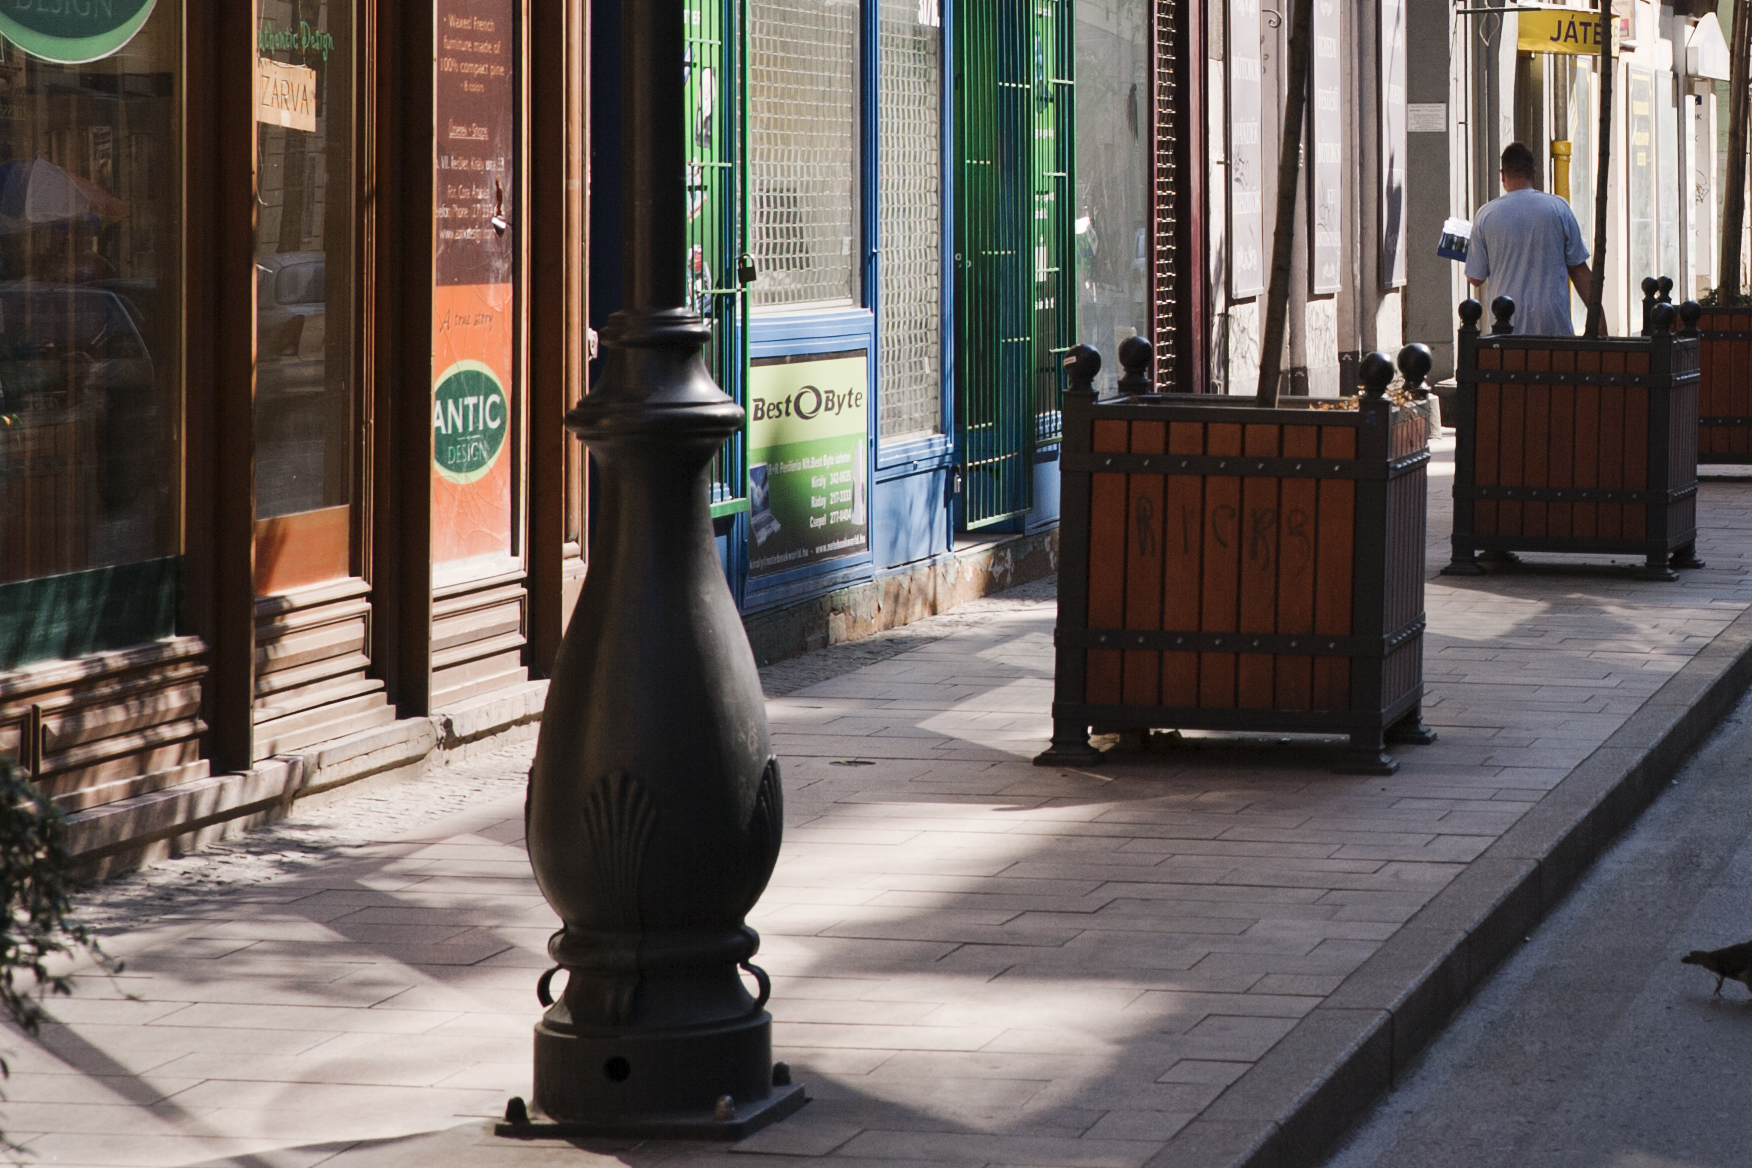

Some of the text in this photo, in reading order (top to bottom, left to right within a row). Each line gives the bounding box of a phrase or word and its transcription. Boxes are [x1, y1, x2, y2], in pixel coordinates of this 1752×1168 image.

[261, 71, 310, 115] ZÁRVA
[434, 393, 501, 435] ANTIC
[448, 442, 490, 465] DESIGN
